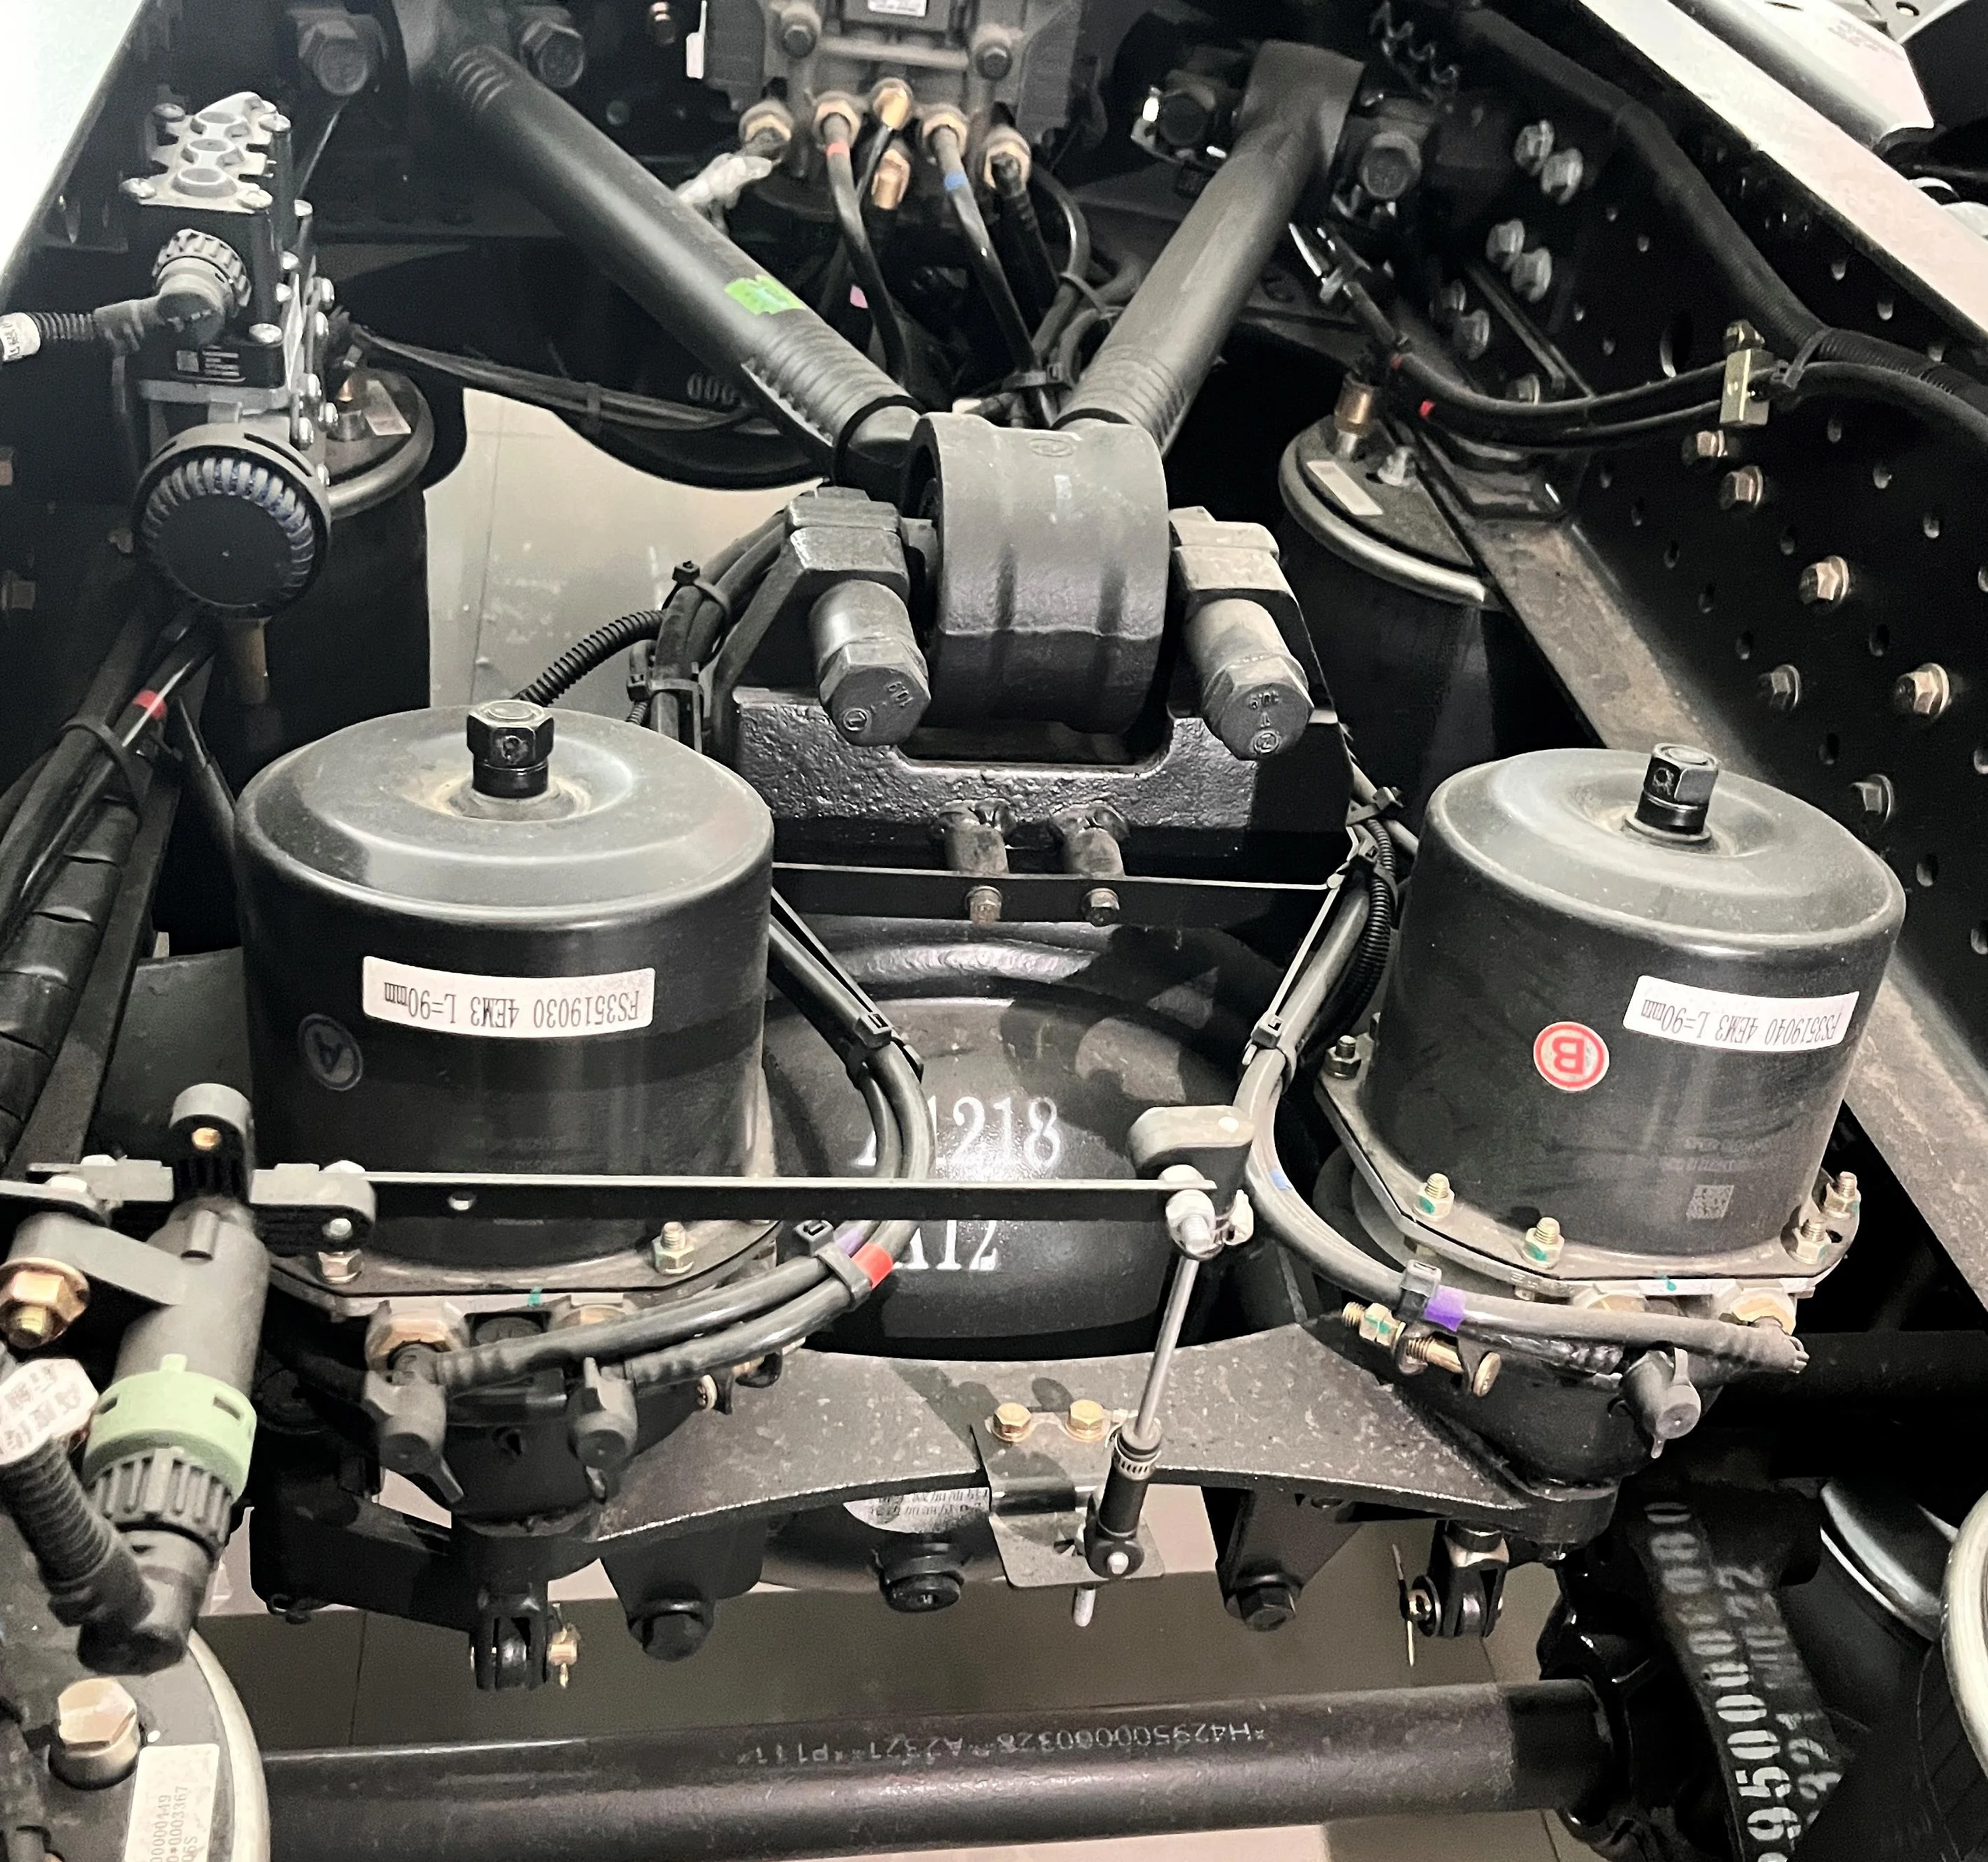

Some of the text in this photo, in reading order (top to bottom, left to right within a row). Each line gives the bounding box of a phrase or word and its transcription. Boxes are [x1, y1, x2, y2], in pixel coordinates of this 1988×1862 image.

[383, 981, 640, 1029] FS3519030 4EM3 L=90mm
[1641, 999, 1843, 1046] FS3519040 4EM3 L=90mm
[1551, 1037, 1585, 1075] B
